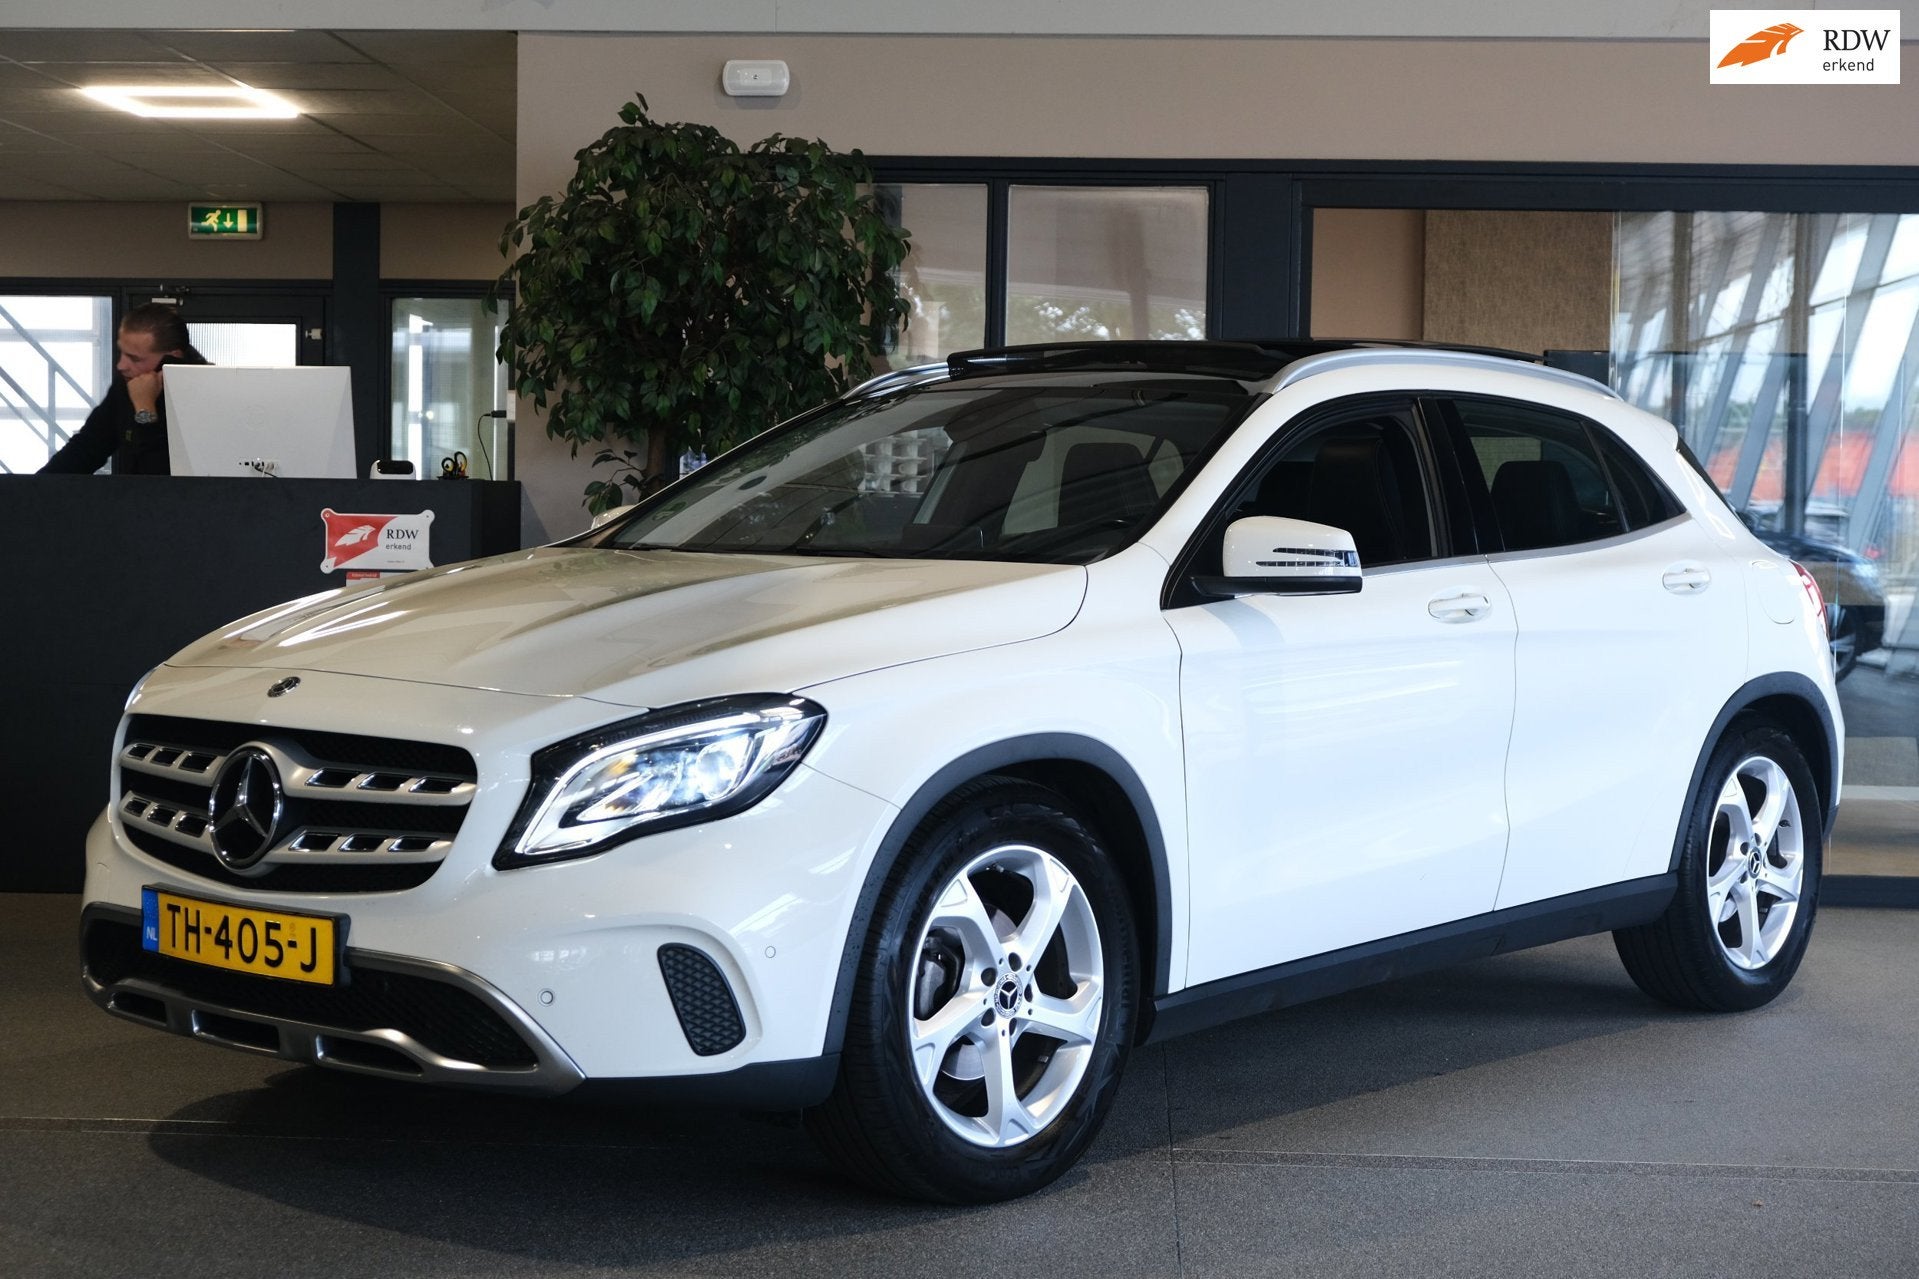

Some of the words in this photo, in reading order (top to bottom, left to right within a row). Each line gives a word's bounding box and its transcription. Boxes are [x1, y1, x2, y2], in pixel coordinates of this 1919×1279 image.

[386, 529, 419, 539] RDW
[146, 926, 158, 941] NL
[167, 903, 317, 973] TH-405-J
